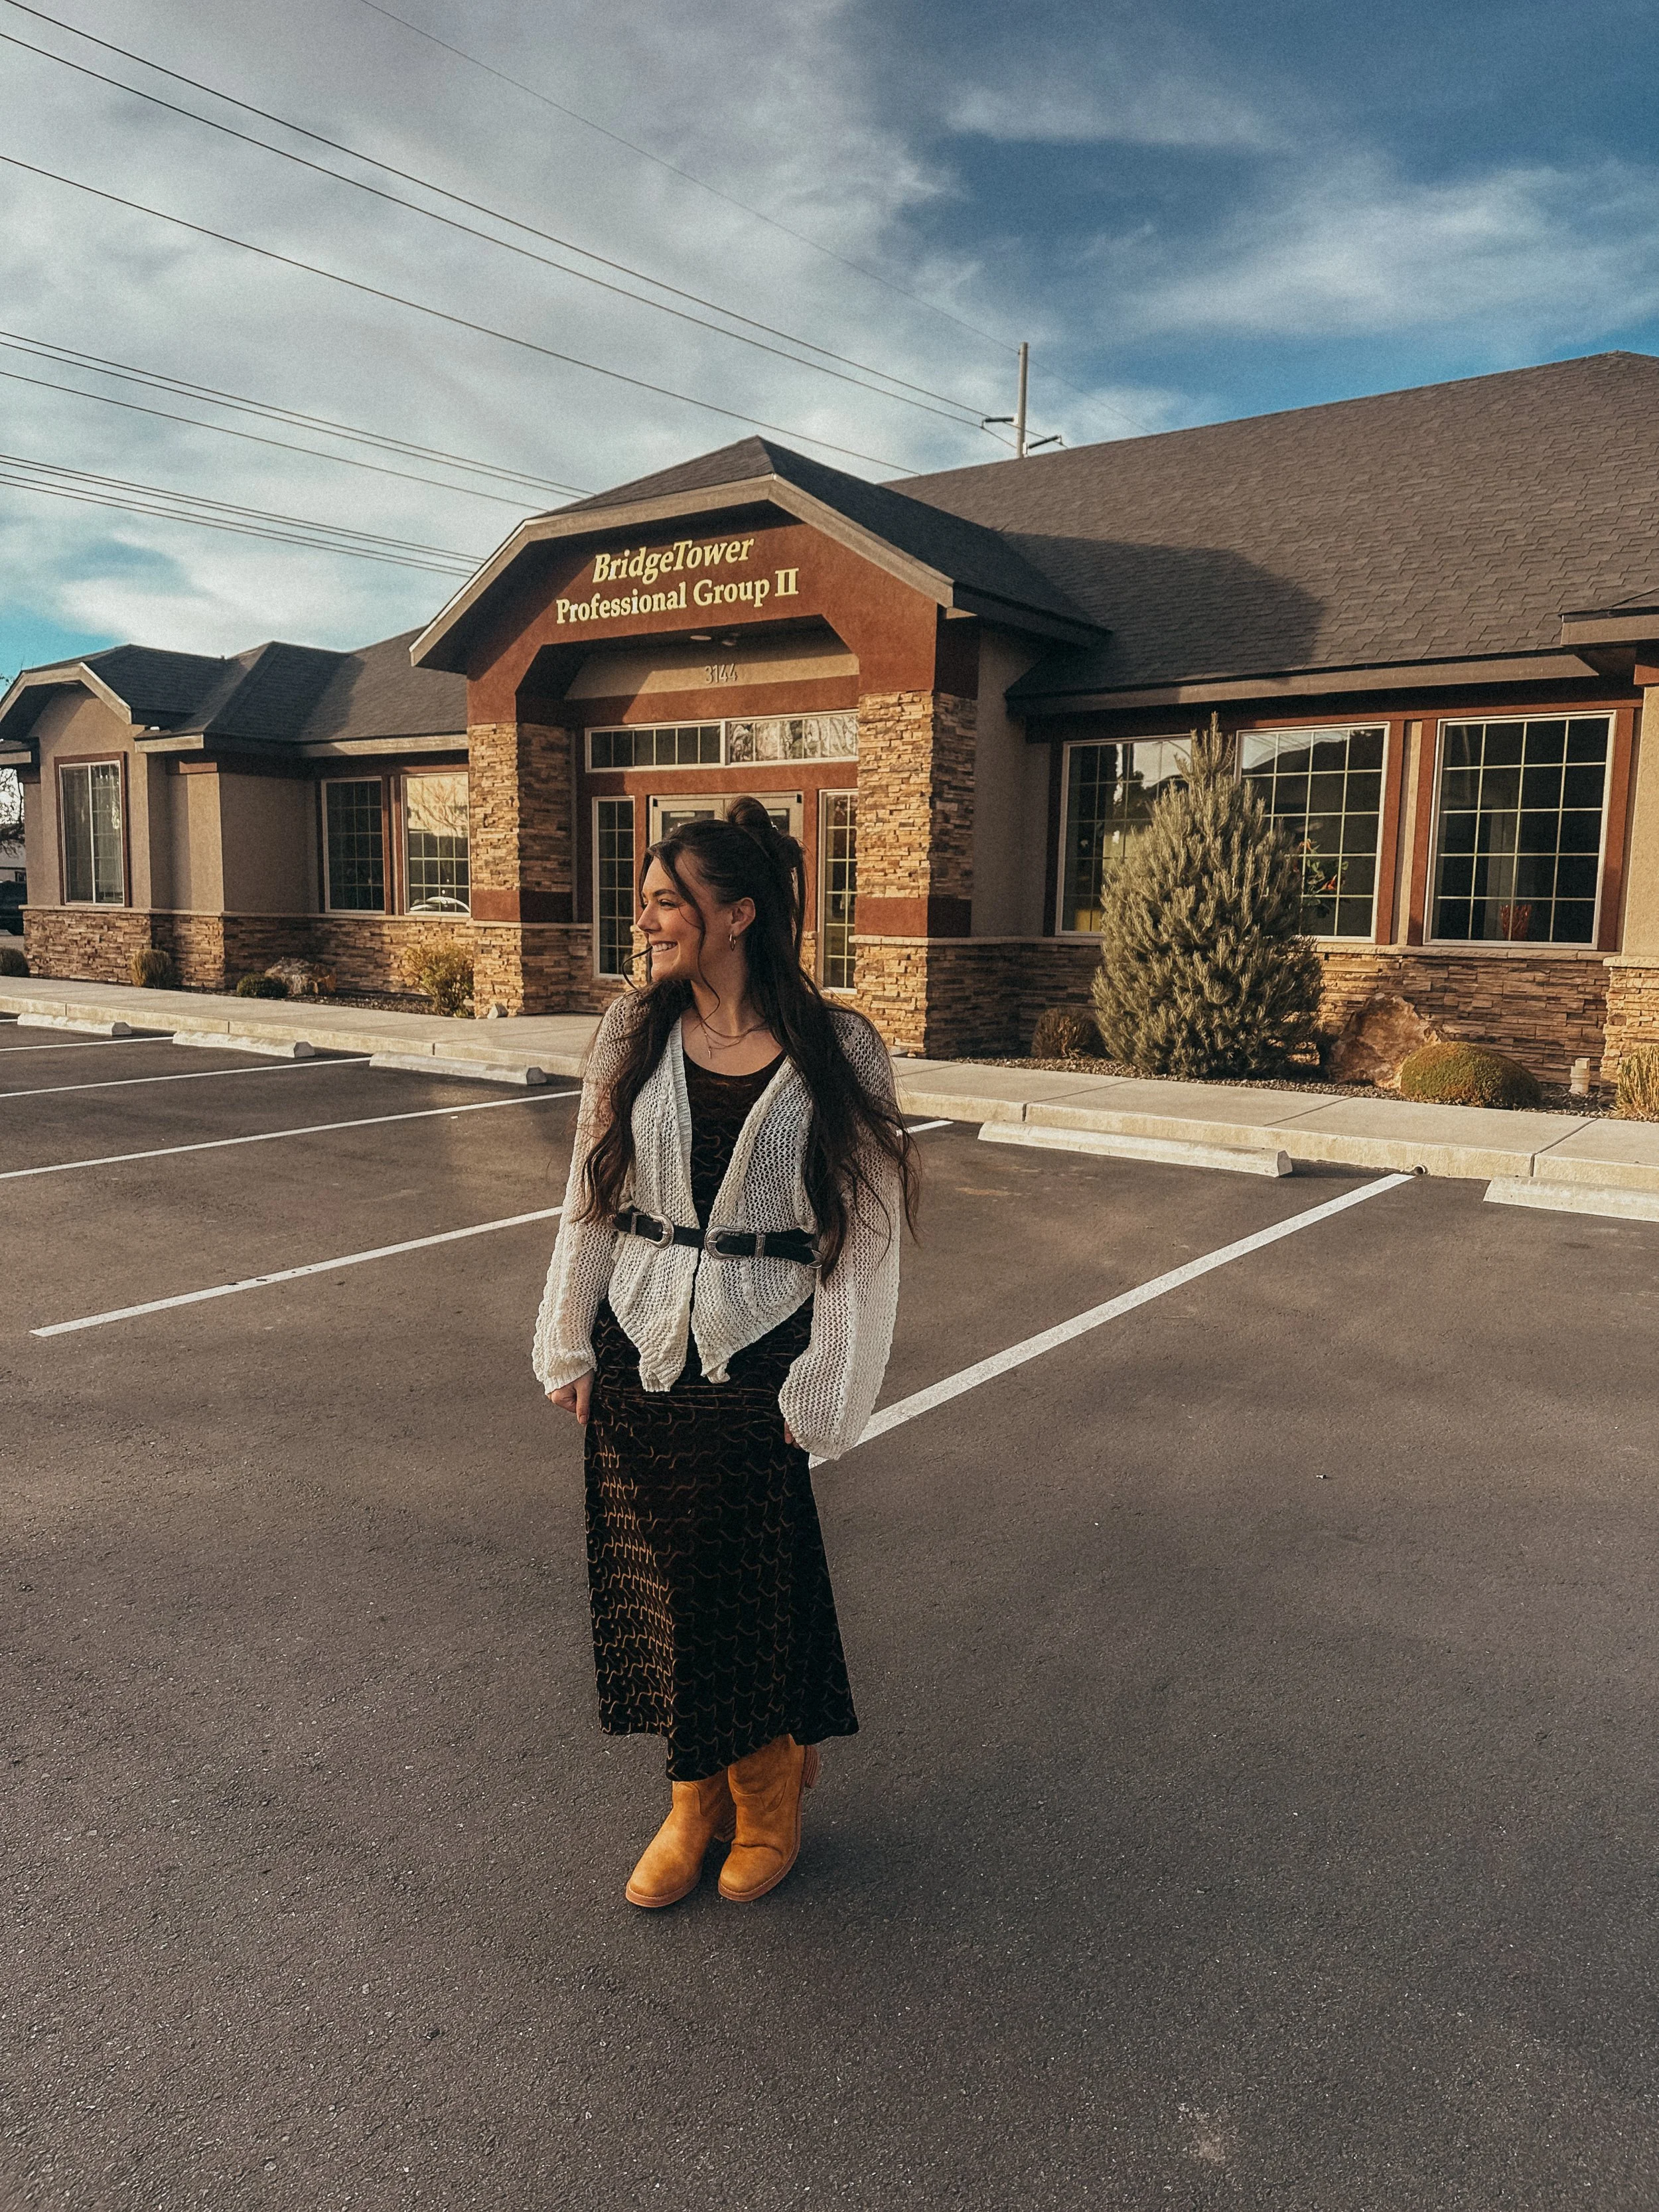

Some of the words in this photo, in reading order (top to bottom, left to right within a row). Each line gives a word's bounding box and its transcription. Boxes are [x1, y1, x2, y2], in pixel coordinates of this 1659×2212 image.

[593, 538, 755, 584] BridgeTower
[556, 582, 687, 624] Professional
[693, 578, 769, 607] Group
[774, 568, 799, 597] II
[705, 664, 738, 684] 3144
